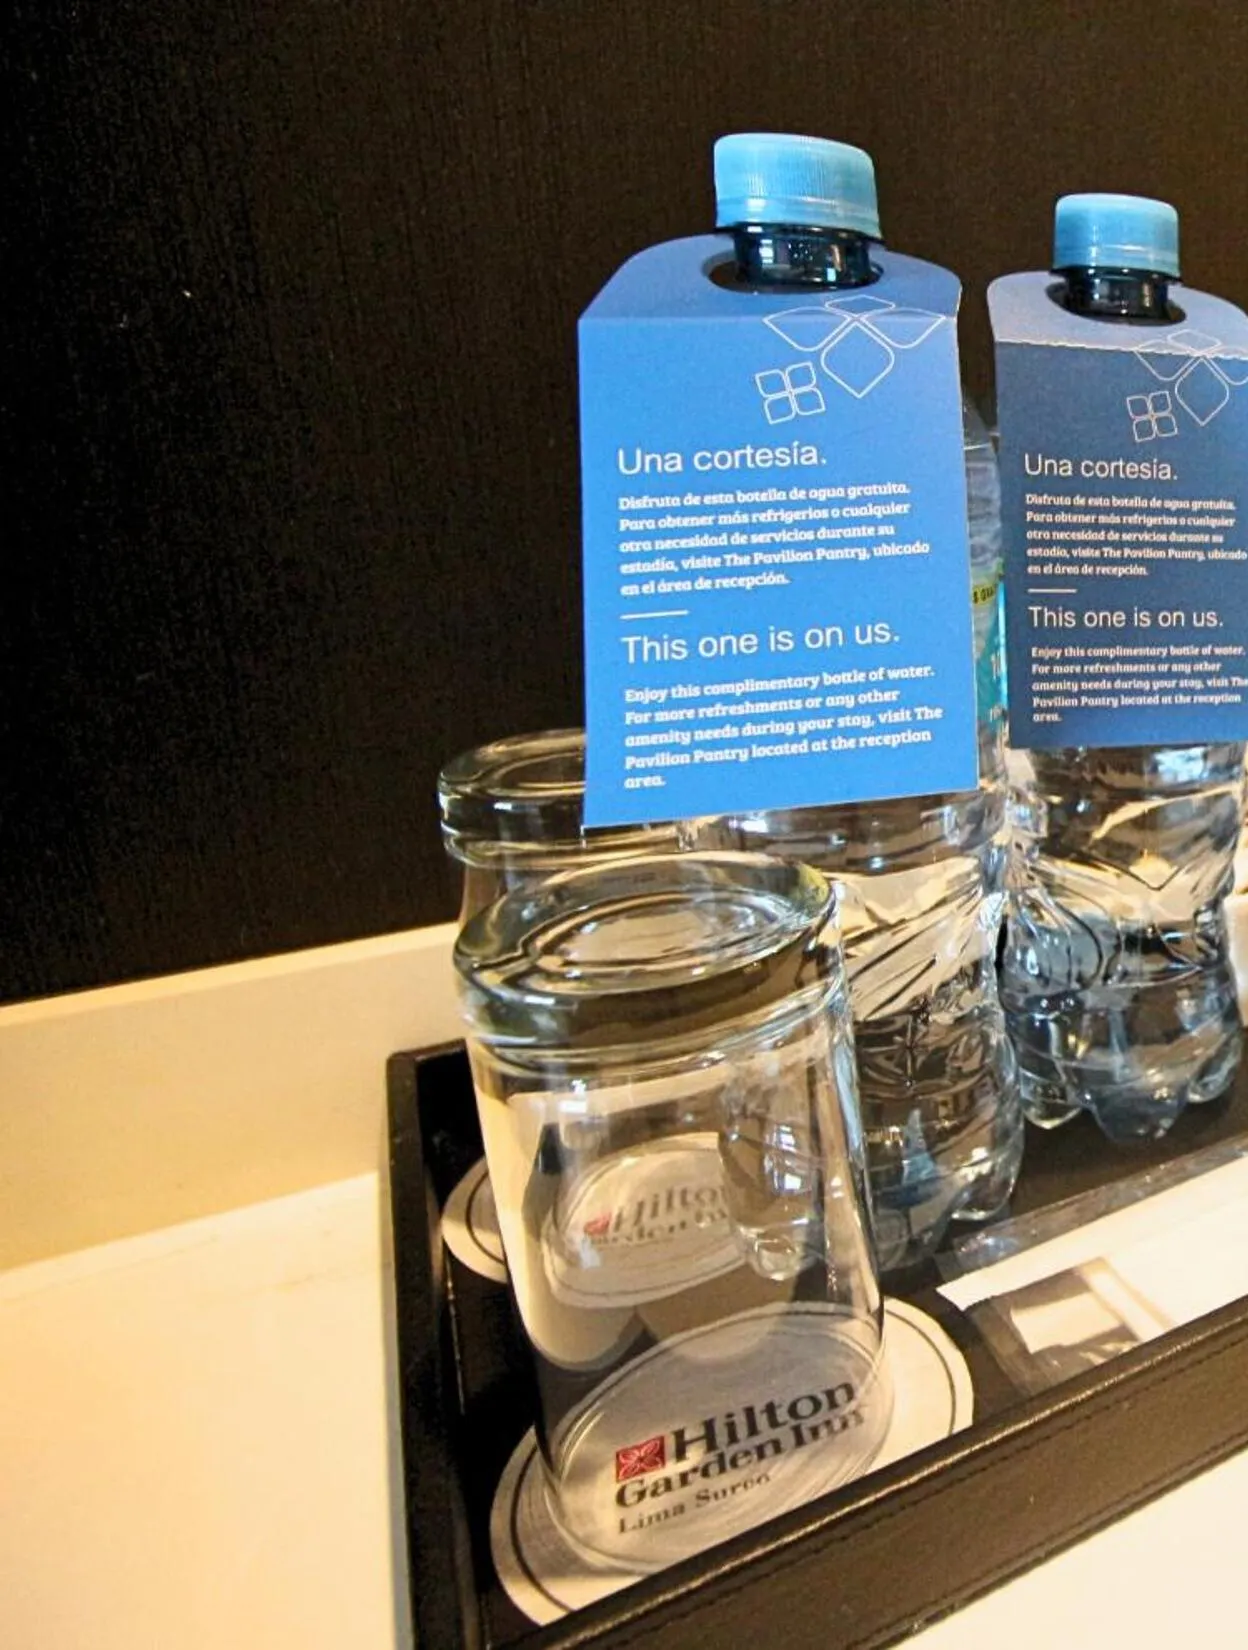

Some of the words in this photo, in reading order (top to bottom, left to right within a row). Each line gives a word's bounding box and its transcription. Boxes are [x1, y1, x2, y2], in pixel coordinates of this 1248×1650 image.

[618, 448, 683, 475] Una
[694, 441, 827, 472] cortesía.
[1025, 453, 1072, 476] Una
[619, 496, 680, 510] Disfruta
[684, 494, 700, 506] de
[704, 493, 734, 504] esta
[738, 488, 786, 503] botella
[789, 488, 805, 500] de
[809, 487, 845, 500] agua
[848, 482, 911, 499] gratuita.
[1026, 494, 1071, 505] Disfruta
[1073, 495, 1085, 506] de
[1088, 496, 1110, 506] esta
[1150, 497, 1161, 508] de
[620, 519, 655, 531] Para
[658, 515, 716, 528] obtener
[718, 511, 749, 524] más
[752, 508, 828, 523] refrigerios
[831, 509, 841, 517] o
[842, 502, 910, 518] cualquier
[1027, 511, 1053, 522] Para
[1055, 511, 1098, 523] obtener
[620, 541, 652, 552] otra
[655, 533, 727, 550] necesidad
[731, 533, 749, 544] de
[750, 528, 814, 543] servicios
[817, 525, 875, 539] durante
[878, 525, 894, 535] su
[1027, 531, 1050, 539] otra
[1052, 530, 1104, 540] necesidad
[1107, 530, 1119, 540] de
[1122, 532, 1167, 542] servicios
[620, 557, 678, 574] estadía,
[682, 555, 721, 569] visite
[724, 553, 750, 566] The
[754, 549, 813, 565] Pavilion
[816, 547, 870, 560] Pantry,
[873, 540, 930, 556] ubicado
[1072, 547, 1099, 557] visite
[1101, 548, 1121, 557] The
[1123, 548, 1165, 559] Pavilion
[1208, 549, 1248, 560] ubicado
[1028, 565, 1041, 573] en
[1043, 563, 1052, 574] el
[1081, 564, 1094, 574] de
[621, 585, 639, 595] en
[642, 581, 655, 593] el
[658, 579, 692, 591] área
[695, 577, 712, 590] de
[715, 572, 790, 589] recepción.
[1029, 607, 1076, 628] This
[1084, 610, 1125, 628] one
[1134, 607, 1151, 628] is
[1159, 610, 1185, 628] on
[1193, 609, 1223, 628] us.
[622, 635, 687, 663] This
[699, 632, 758, 657] one
[769, 626, 794, 651] is
[805, 624, 844, 649] on
[855, 621, 899, 644] us.
[1031, 647, 1062, 659] Enjoy
[1064, 647, 1085, 656] this
[1087, 645, 1168, 658] complimentary
[1170, 645, 1199, 655] bottle
[1202, 645, 1212, 655] of
[1032, 664, 1051, 673] For
[1053, 665, 1082, 673] more
[1084, 662, 1155, 672] refreshments
[1171, 663, 1191, 673] any
[1193, 661, 1221, 671] other
[625, 688, 667, 703] Enjoy
[671, 685, 700, 698] this
[704, 674, 820, 696] complimentary
[823, 670, 866, 685] bottle
[869, 668, 885, 680] of
[888, 665, 935, 679] water.
[1032, 680, 1078, 692] amenity
[1081, 680, 1112, 689] needs
[1114, 678, 1150, 690] during
[1152, 680, 1176, 690] your
[1207, 677, 1229, 686] visit
[1230, 677, 1248, 687] The
[625, 712, 651, 724] For
[655, 709, 694, 722] more
[699, 699, 802, 718] refreshments
[805, 696, 822, 708] or
[826, 695, 854, 708] any
[858, 689, 900, 703] other
[1032, 696, 1078, 707] Pavilion
[1080, 696, 1118, 708] Pantry
[1121, 694, 1159, 705] located
[1162, 696, 1172, 704] at
[1175, 694, 1191, 704] the
[1194, 694, 1241, 705] reception
[625, 731, 691, 747] amenity
[694, 725, 739, 740] needs
[742, 721, 794, 736] during
[798, 718, 834, 733] your
[838, 714, 875, 728] stay,
[878, 709, 912, 723] visit
[914, 706, 943, 719] The
[625, 752, 690, 769] Pavilion
[693, 747, 748, 761] Pantry
[752, 740, 808, 757] located
[812, 738, 828, 751] at
[831, 736, 856, 749] the
[860, 730, 931, 747] reception
[624, 775, 666, 788] area.
[671, 1380, 856, 1462] Hilton
[615, 1437, 784, 1508] Garden
[794, 1404, 866, 1448] Inn
[618, 1502, 686, 1535] Lima
[695, 1471, 772, 1509] Surco
